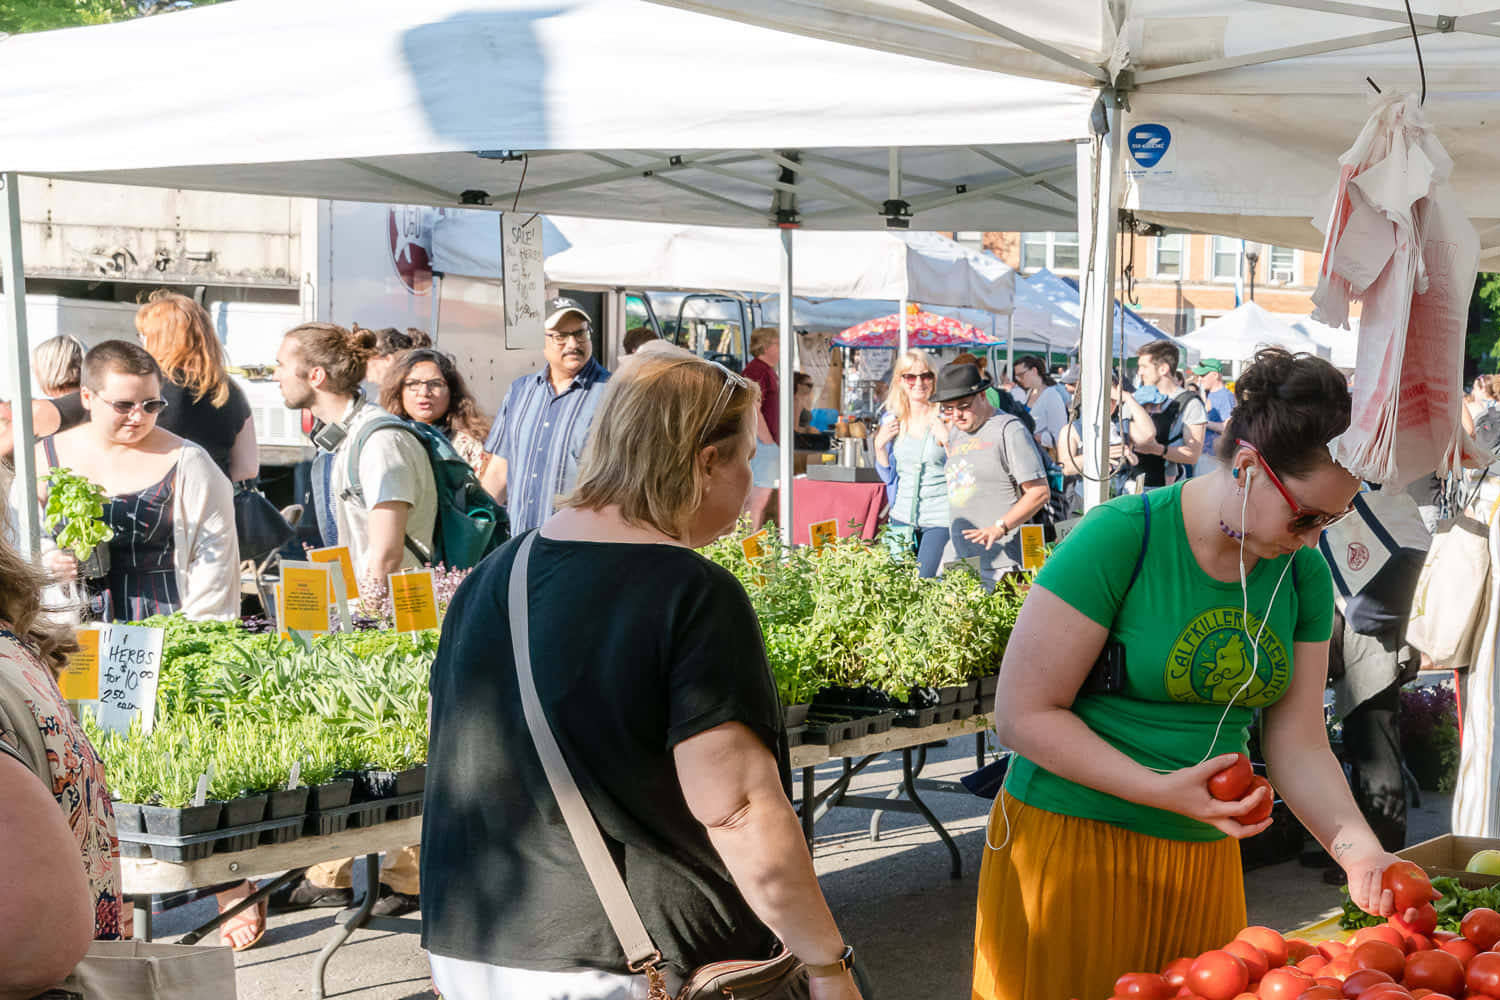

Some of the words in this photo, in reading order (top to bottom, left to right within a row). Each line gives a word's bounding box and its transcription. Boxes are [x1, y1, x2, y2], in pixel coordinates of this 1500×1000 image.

[109, 645, 154, 665] HERBS
[1170, 610, 1243, 680] CALFKILLER
[1255, 627, 1287, 699] BREWING
[104, 666, 121, 684] for
